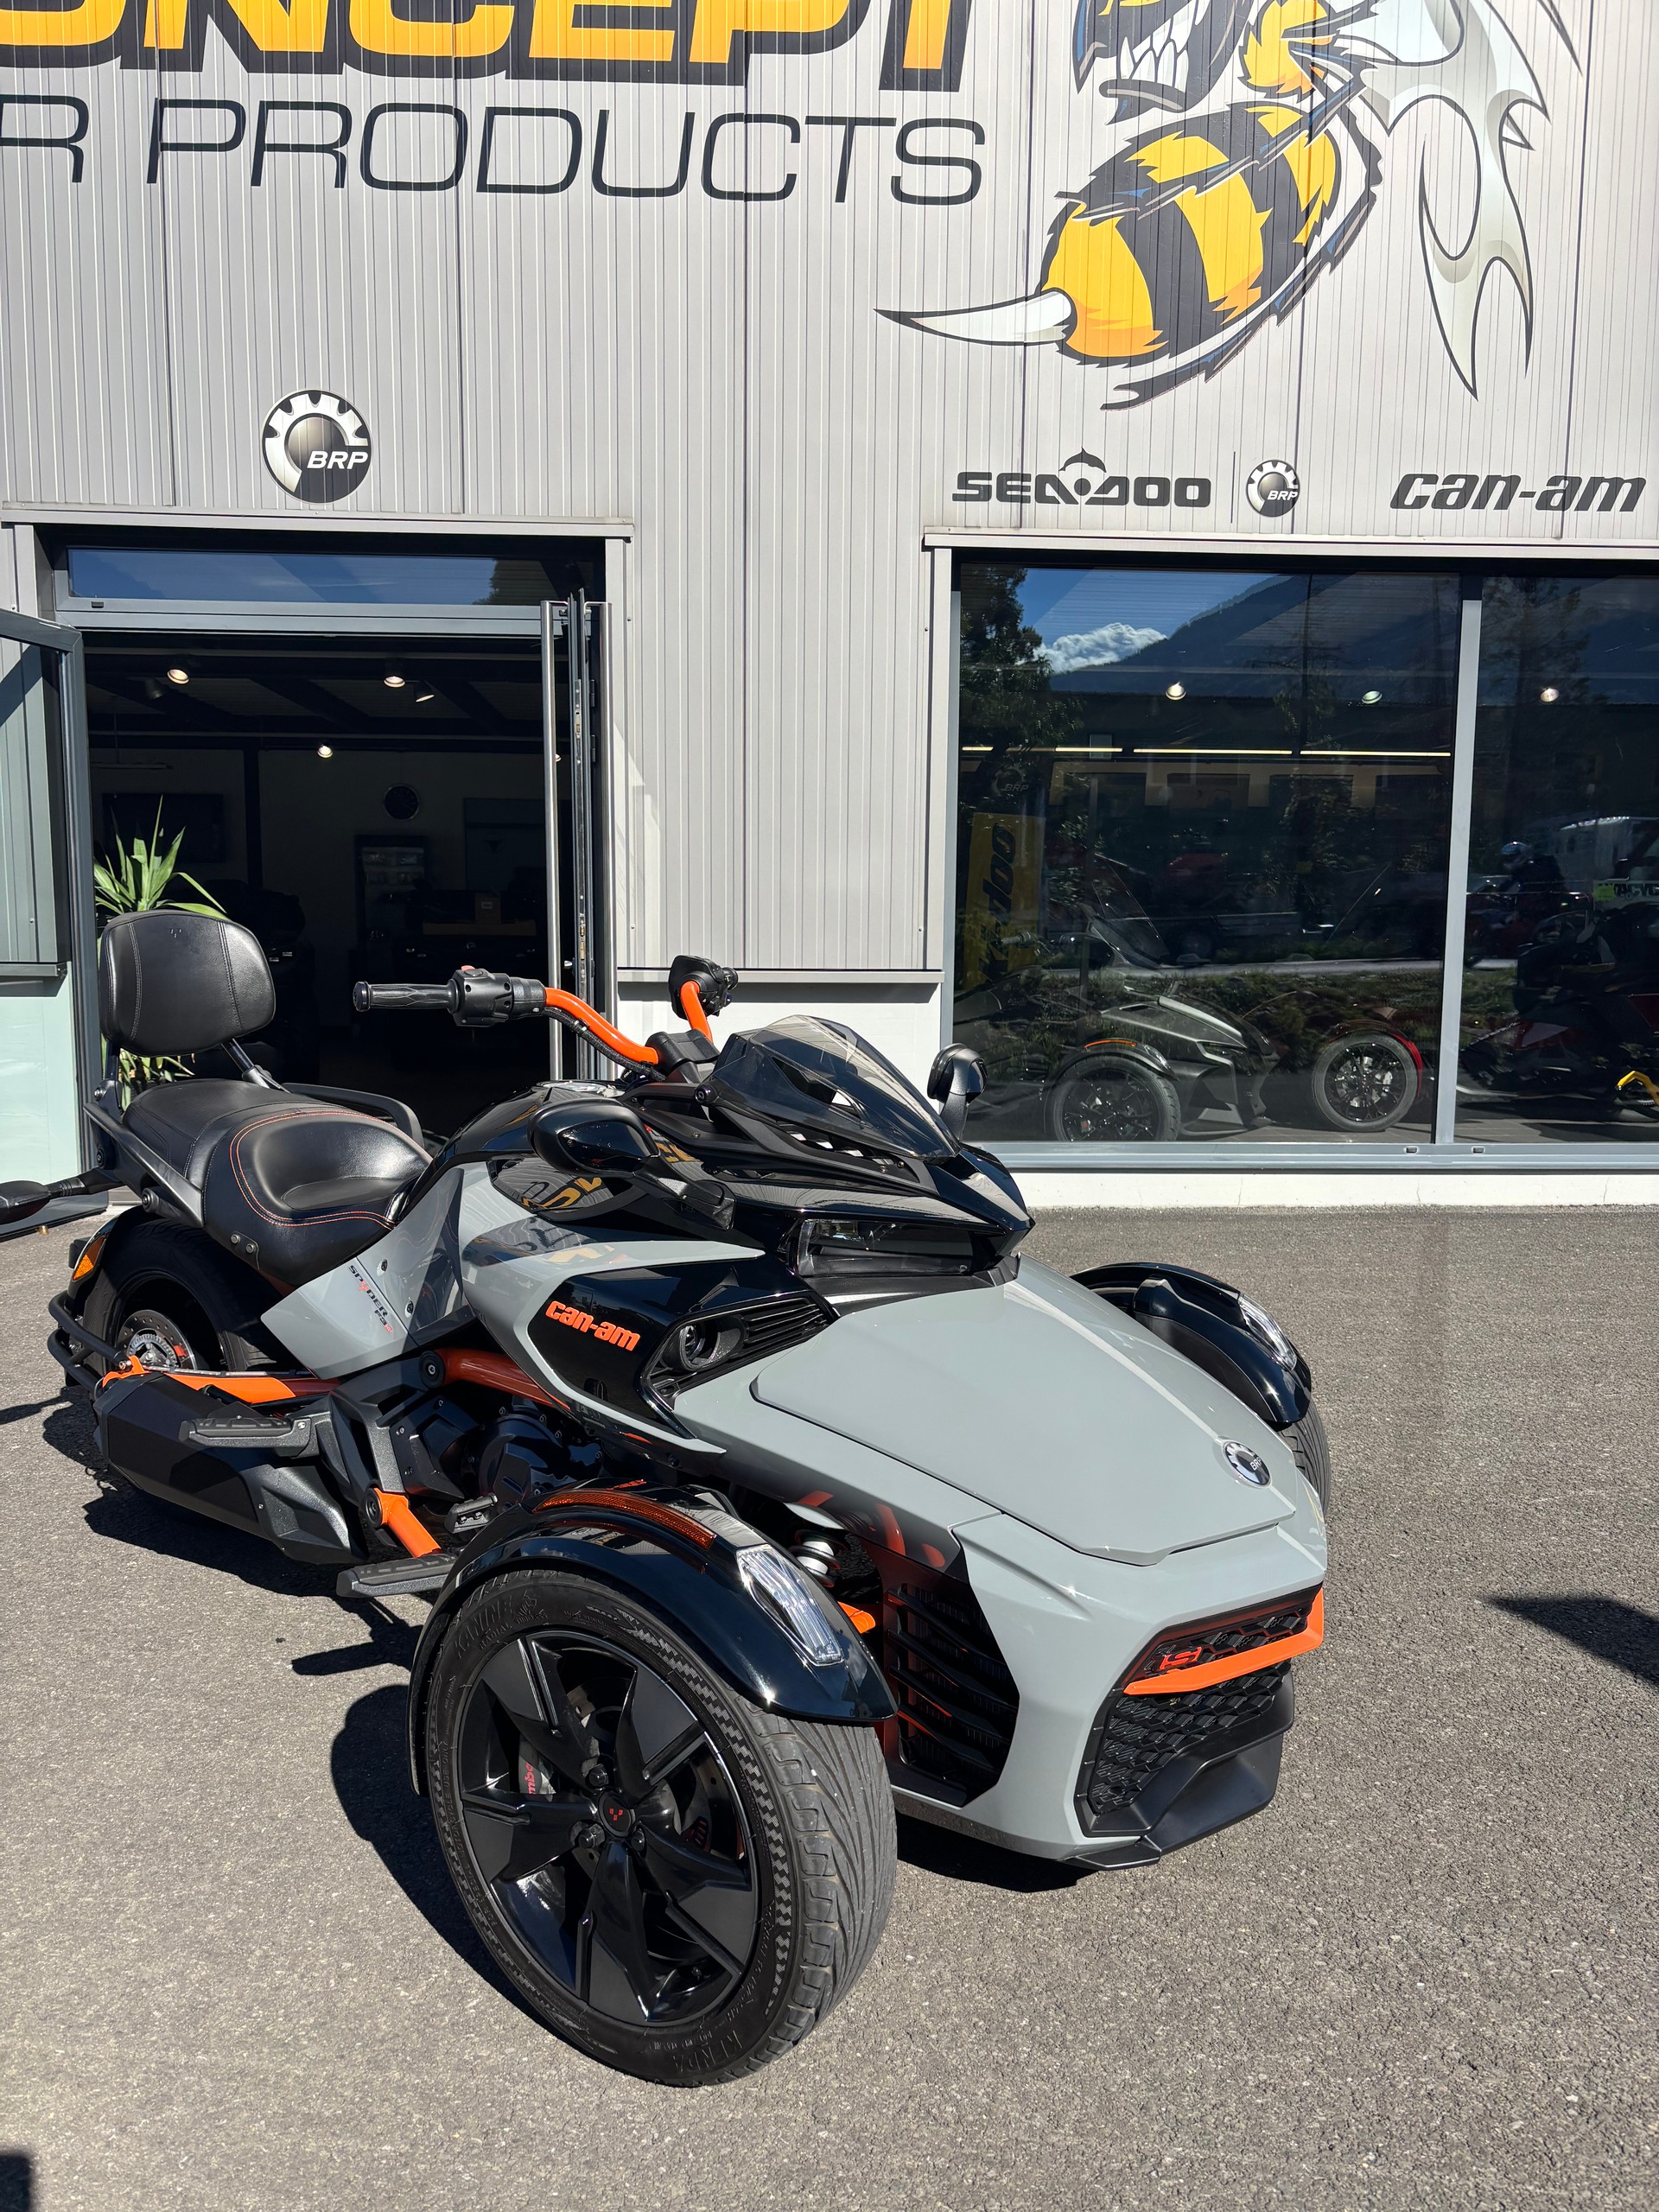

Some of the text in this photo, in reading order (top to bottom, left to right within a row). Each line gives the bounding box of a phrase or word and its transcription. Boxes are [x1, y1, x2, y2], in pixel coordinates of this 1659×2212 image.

[146, 97, 986, 206] PRODUCTS
[307, 450, 369, 470] BRP
[1267, 490, 1298, 501] BRP
[1389, 474, 1647, 512] can-am
[1003, 783, 1029, 793] BRP
[545, 1300, 640, 1352] can-am
[1249, 1456, 1262, 1471] BRP
